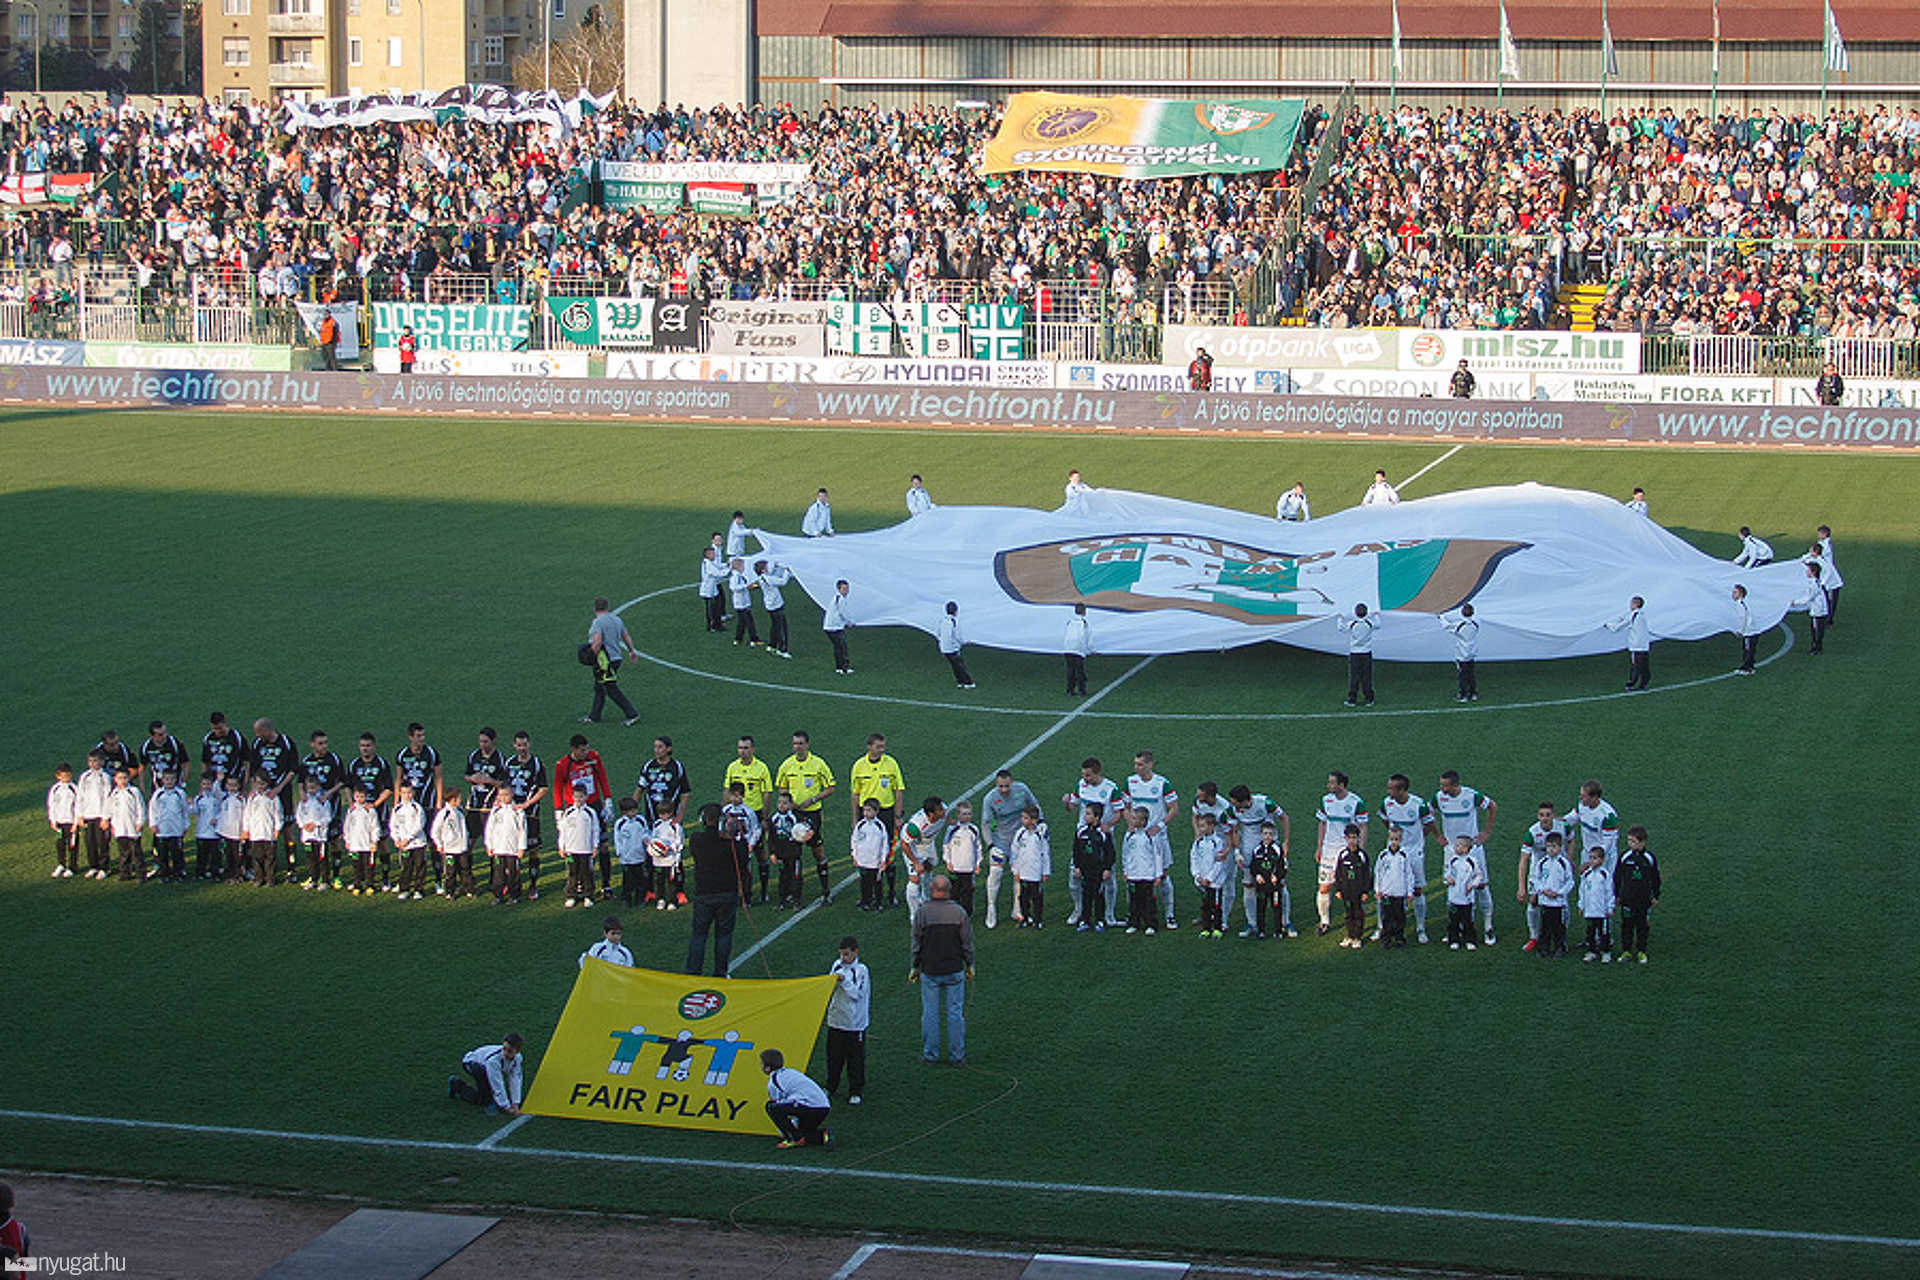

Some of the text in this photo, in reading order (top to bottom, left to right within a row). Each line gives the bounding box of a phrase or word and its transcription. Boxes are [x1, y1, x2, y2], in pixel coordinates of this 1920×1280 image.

[372, 302, 532, 338] DOGS ELITE
[389, 334, 513, 351] HOLIGANS
[1220, 332, 1331, 365] otpbank
[1462, 334, 1624, 359] mlsz.hu
[46, 370, 321, 402] www.techfront.hu
[884, 364, 991, 382] HYUNDAI
[1101, 372, 1247, 393] SZOMBAELY
[392, 381, 406, 400] A
[449, 381, 563, 409] technológiája
[569, 389, 581, 404] a
[585, 387, 651, 411] magyar
[654, 385, 732, 411] sportban
[1332, 379, 1525, 400] SOPRON ANK
[1574, 390, 1652, 402] Marketing
[1660, 386, 1772, 404] FIORA KFT
[816, 388, 1116, 422] www.techfront.hu
[1194, 402, 1209, 420] A
[1255, 400, 1383, 427] technológiája
[1387, 409, 1400, 424] a
[1404, 408, 1479, 431] magyar
[1481, 405, 1564, 431] sportban
[569, 1083, 749, 1122] FAIR PLAY
